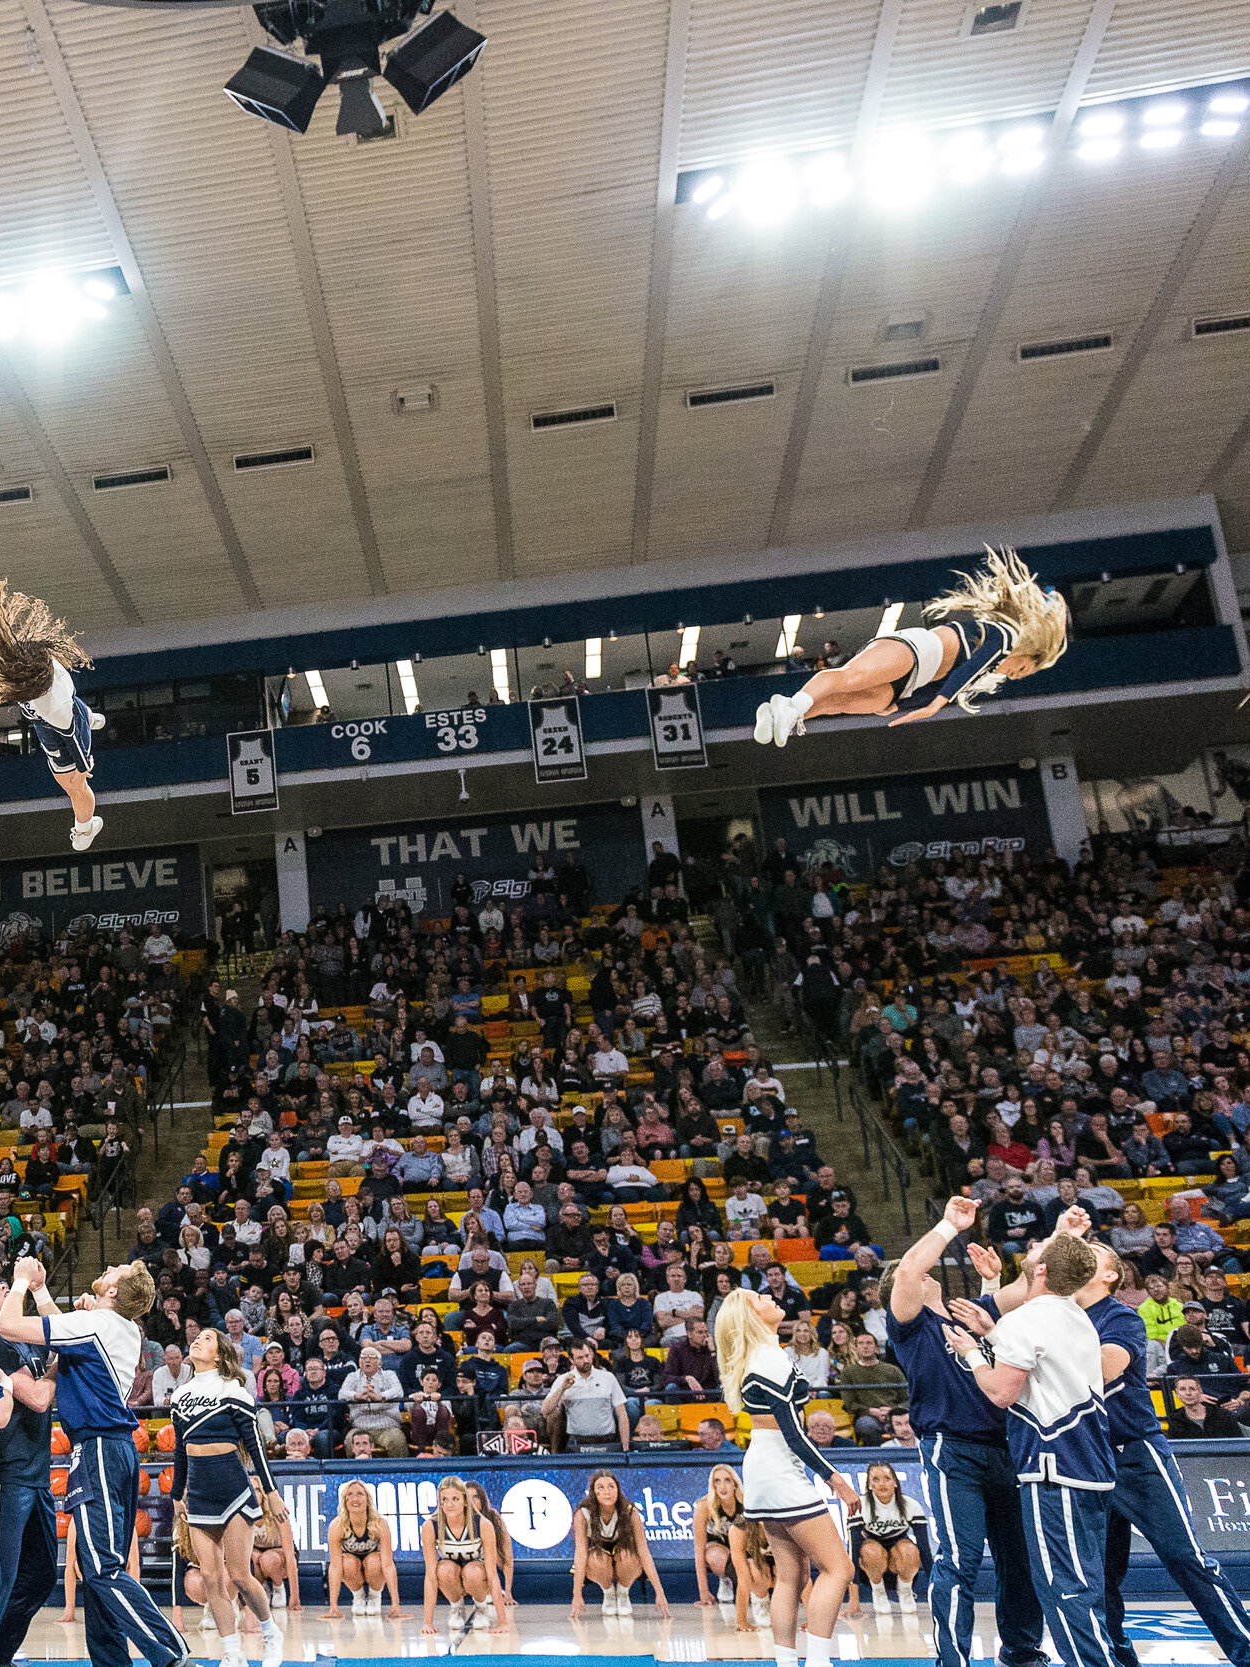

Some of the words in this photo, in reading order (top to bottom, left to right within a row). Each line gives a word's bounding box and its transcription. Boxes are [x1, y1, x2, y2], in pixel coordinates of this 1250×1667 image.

[425, 708, 487, 728] ESTES
[331, 720, 387, 739] COOK
[436, 724, 479, 751] 33
[663, 723, 692, 742] 31
[351, 736, 371, 760] 6
[542, 735, 575, 756] 24
[240, 758, 264, 766] GRANT
[1051, 764, 1068, 780] B
[246, 768, 260, 786] 5
[651, 802, 666, 818] A
[789, 791, 902, 828] WILL
[924, 779, 1022, 816] WIN
[284, 837, 298, 853] A
[370, 828, 488, 866] THAT
[510, 819, 580, 853] WE
[22, 858, 179, 899] BELIEVE
[492, 880, 532, 899] Sig
[97, 913, 142, 932] Sign
[143, 910, 180, 926] Pro
[178, 1392, 218, 1413] Aggies
[1203, 1478, 1250, 1517] Fi
[526, 1496, 547, 1530] F
